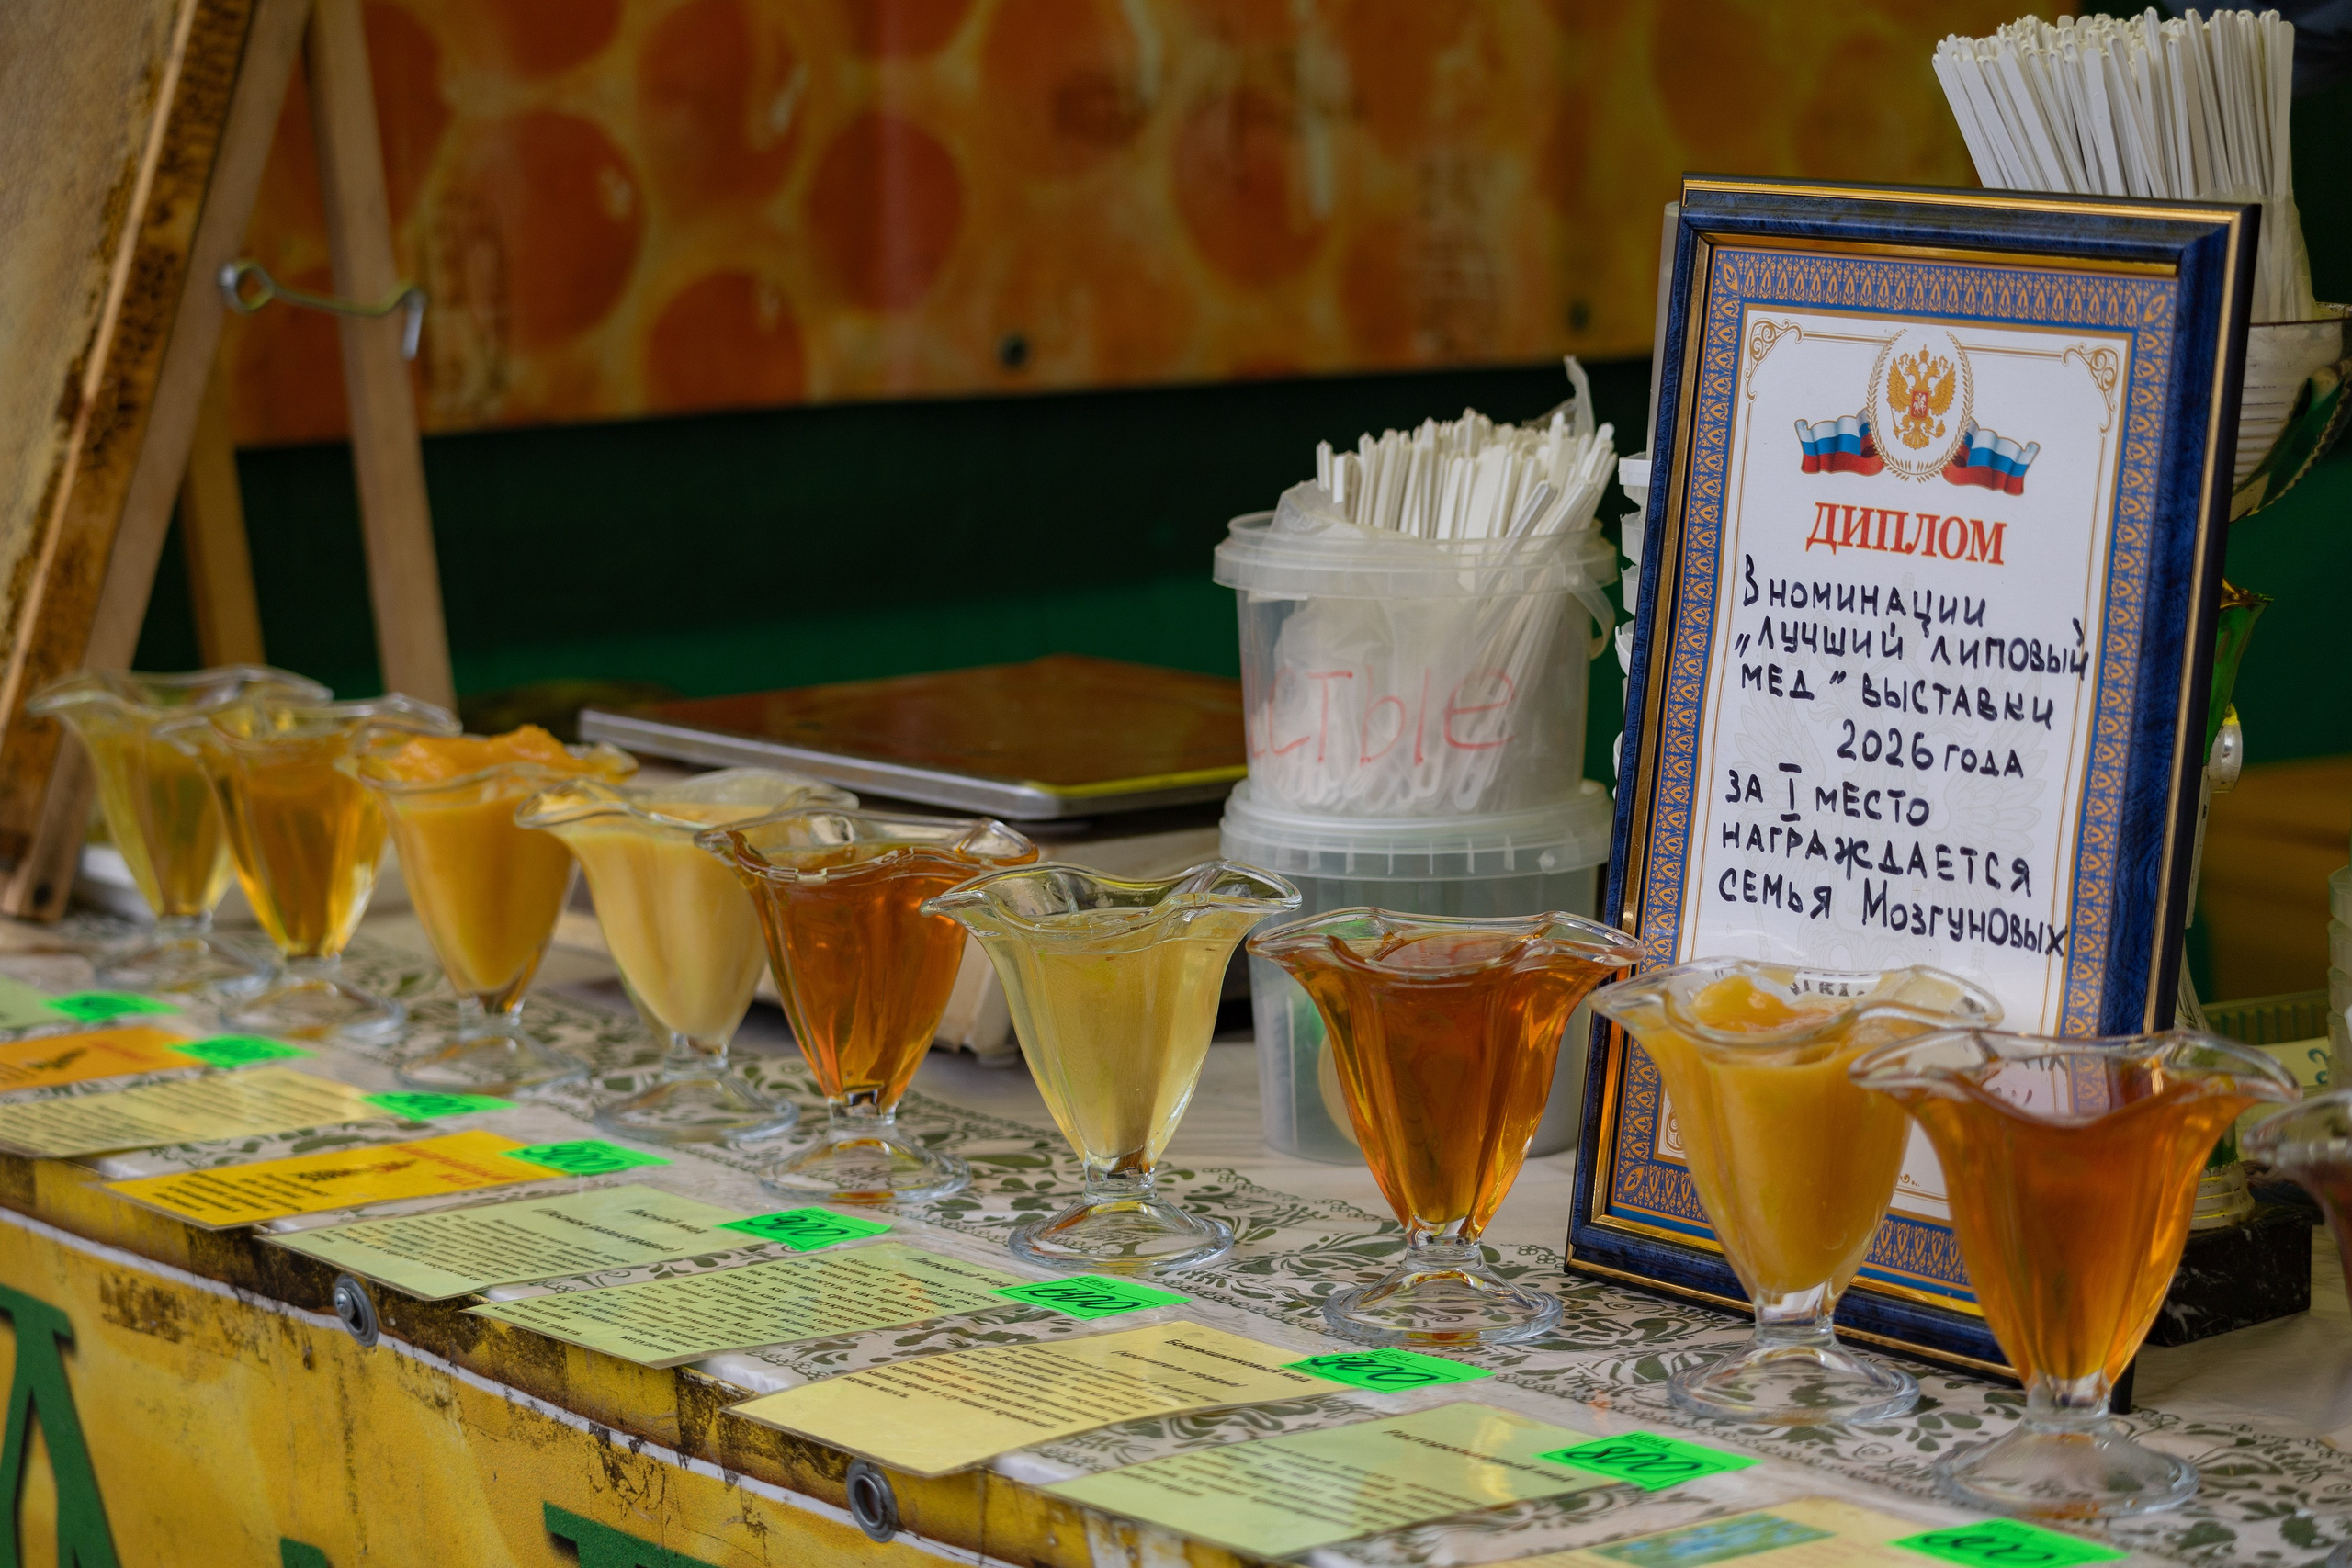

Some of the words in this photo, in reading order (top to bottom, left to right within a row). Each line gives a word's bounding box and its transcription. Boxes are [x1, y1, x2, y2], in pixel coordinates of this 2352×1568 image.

[1806, 501, 2007, 566] ДИПЛОМ
[1744, 553, 1759, 607] В
[1768, 578, 1987, 638] НОМИНАЦИИ
[1930, 617, 2089, 681] ЛИПОВЫЙ
[1861, 673, 2054, 731] ВЫСТАВКИ
[1837, 718, 1934, 772] 2026
[1943, 743, 2024, 780] ГОДА
[1724, 769, 1764, 804] ЗА
[1815, 784, 1930, 827] МЕСТО
[1722, 821, 2032, 898] НАГРАЖДАЕТСЯ
[1718, 867, 1832, 920] СЕМЬЯ
[746, 1215, 851, 1237] 900
[908, 1256, 980, 1278] Липовый
[976, 1275, 1009, 1288] мед
[1020, 1288, 1142, 1310] 1300
[1166, 1338, 1283, 1373] Боярышниковый
[1279, 1371, 1310, 1382] мед
[1310, 1356, 1440, 1382] 900
[1385, 1428, 1534, 1470] Расторопшевый
[1531, 1468, 1572, 1483] мед
[1564, 1446, 1702, 1472] 800
